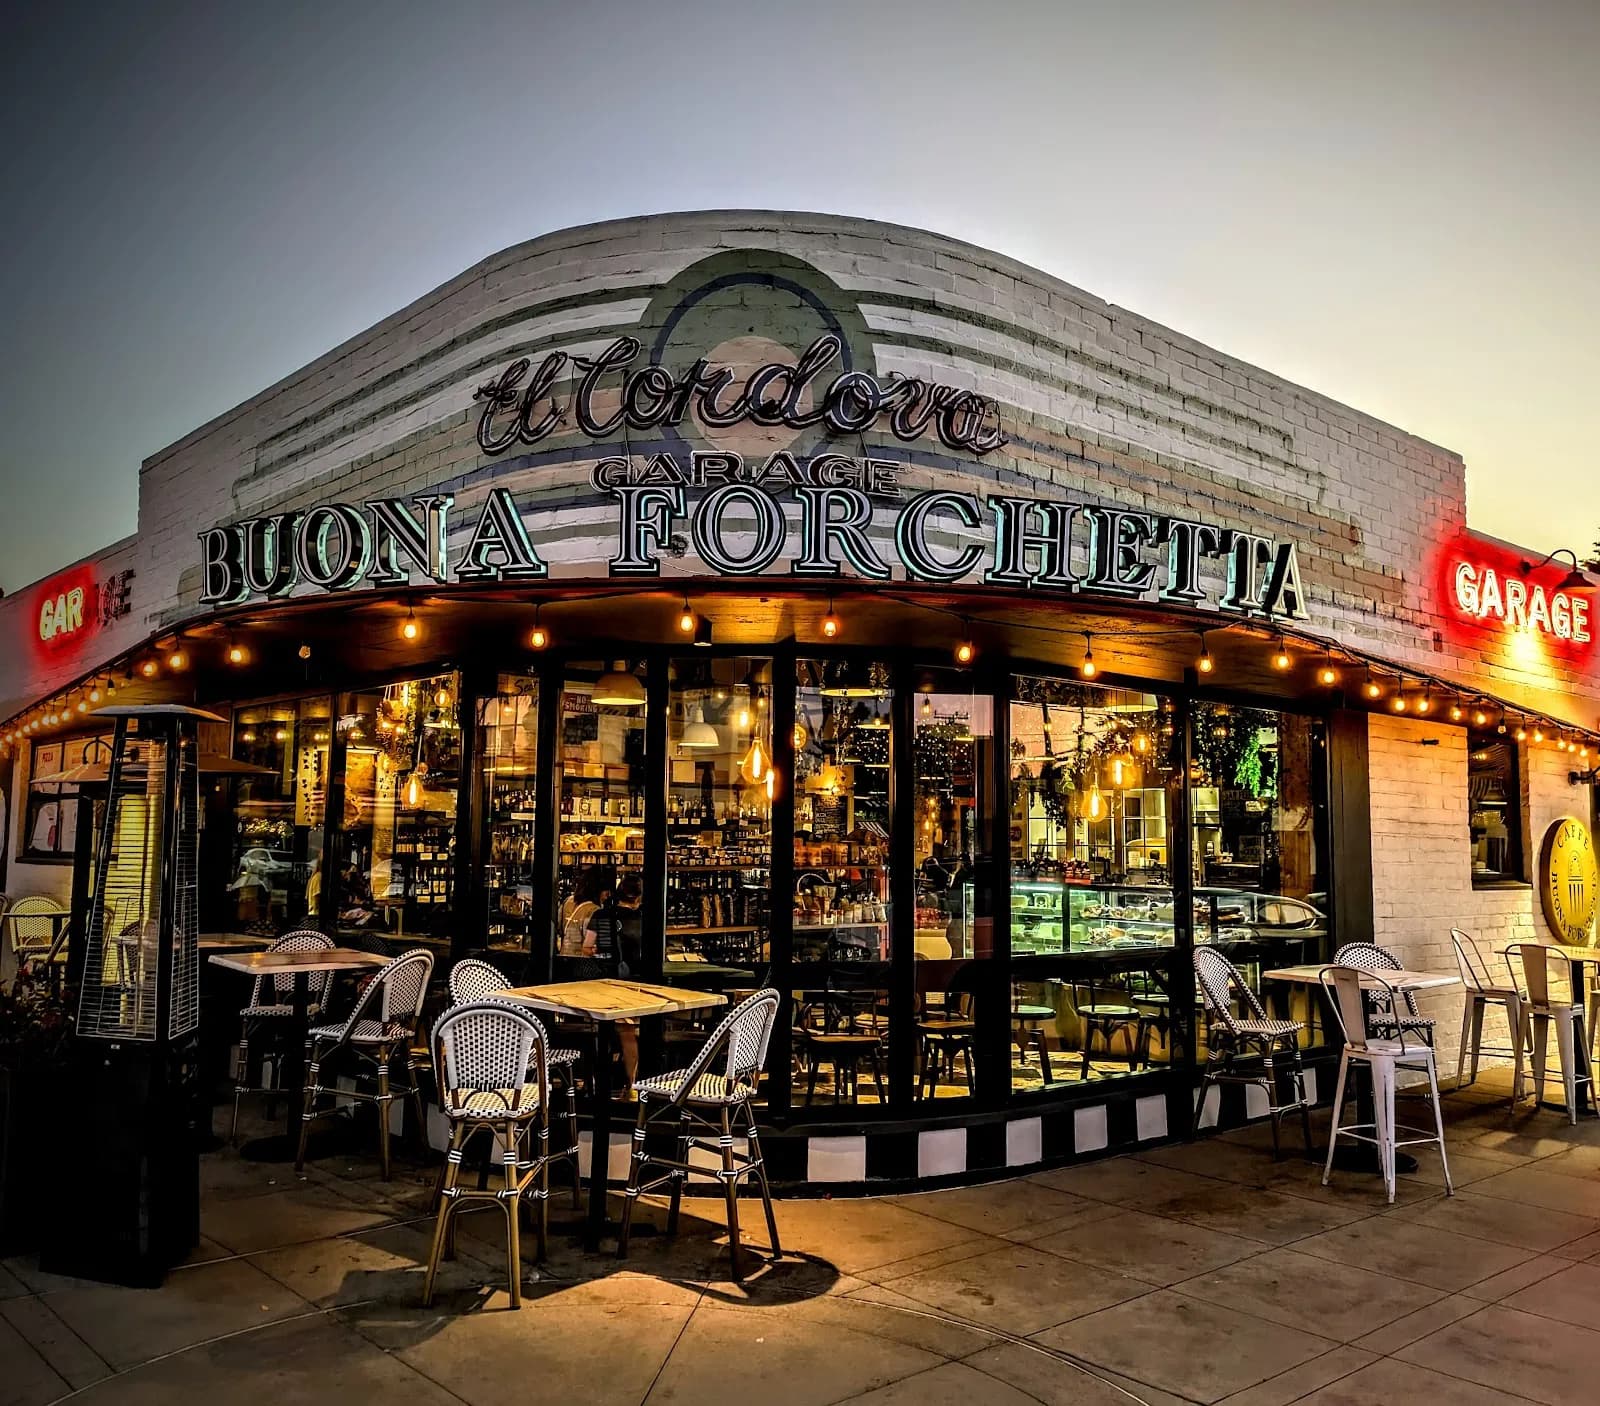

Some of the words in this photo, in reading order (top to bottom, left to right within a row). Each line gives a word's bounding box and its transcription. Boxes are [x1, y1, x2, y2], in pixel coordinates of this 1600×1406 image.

[571, 334, 1009, 456] Cordova
[589, 450, 907, 497] GARAGE
[198, 487, 549, 606] BUONA
[610, 483, 1310, 624] FORCHETTA
[1455, 561, 1591, 643] GARAGE
[563, 701, 598, 713] SMOKING
